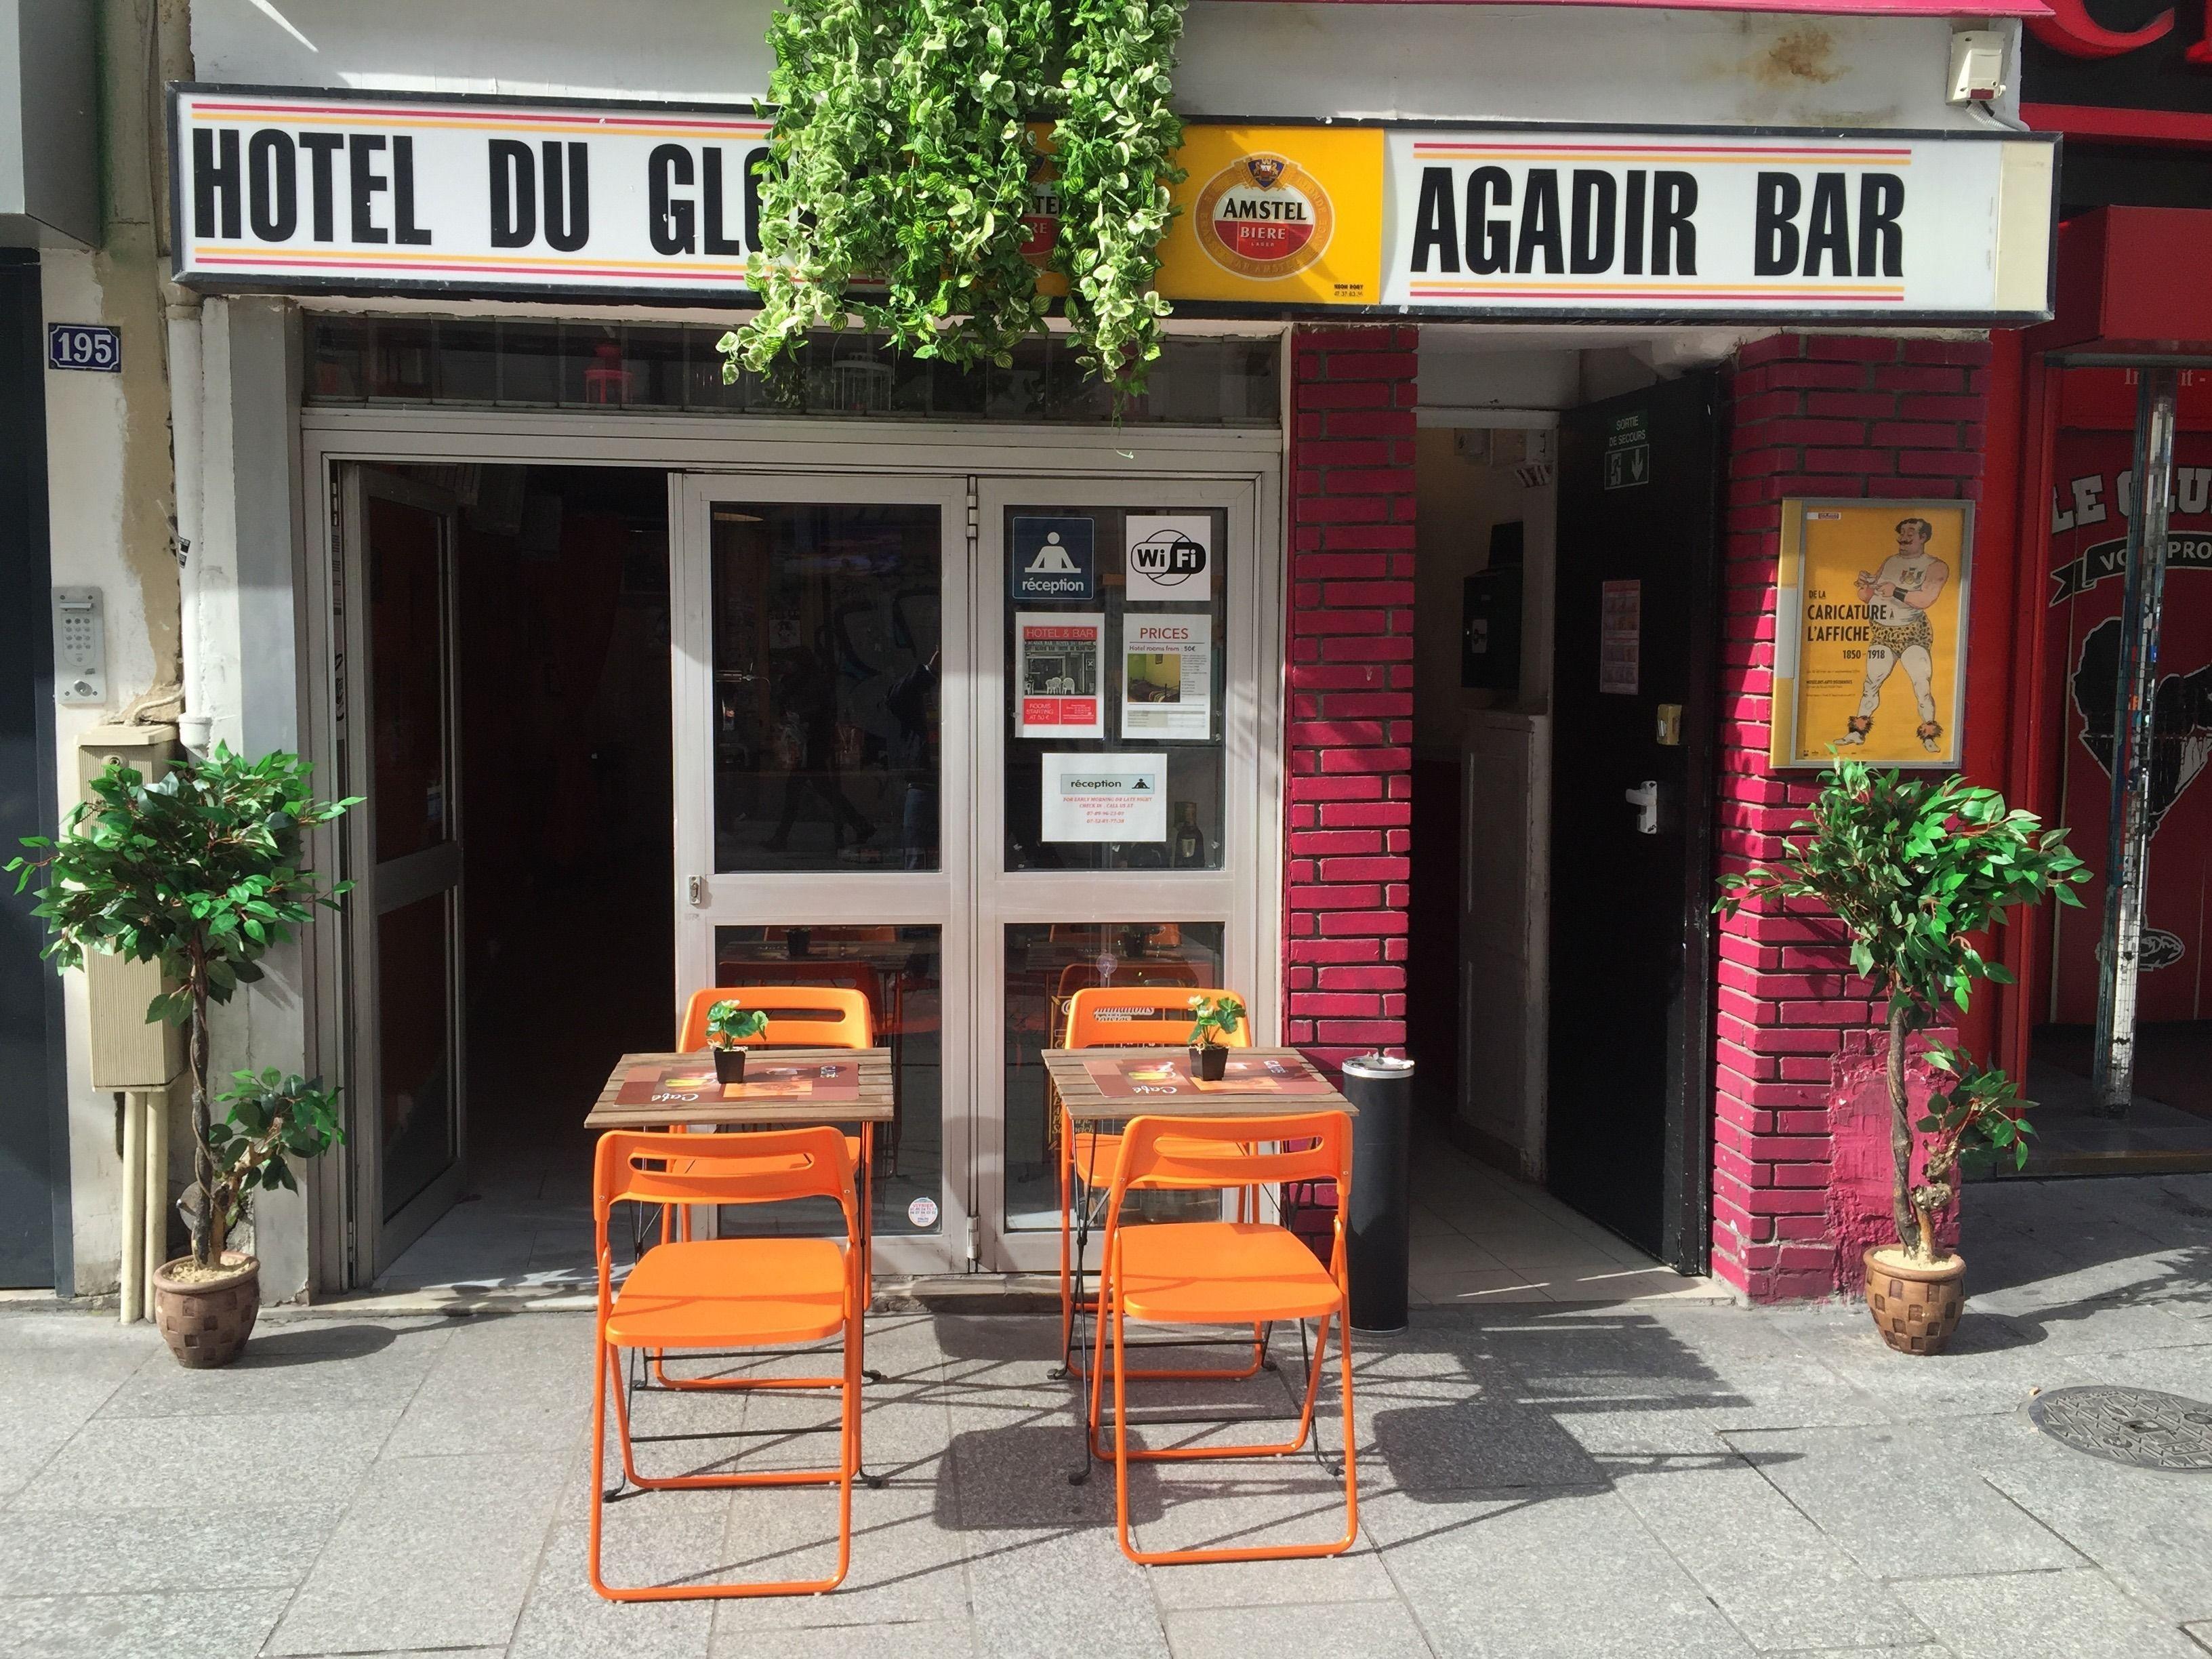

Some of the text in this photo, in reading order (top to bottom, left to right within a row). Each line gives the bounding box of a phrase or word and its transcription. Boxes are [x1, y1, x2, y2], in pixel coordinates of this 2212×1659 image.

[192, 127, 432, 245] HOTEL
[489, 138, 590, 253] DU
[1223, 197, 1307, 221] AMSTEL
[1410, 165, 1906, 277] AGADIR BAR
[1240, 226, 1286, 239] BIERE
[58, 332, 112, 363] 195
[1616, 415, 1639, 431] SORTIE
[1609, 429, 1646, 447] DE SECOURS
[2051, 474, 2106, 534] LE
[1022, 577, 1084, 594] réception
[1809, 590, 1817, 598] DE
[1807, 604, 1887, 620] CARICATURE
[1026, 628, 1060, 638] HOTEL
[1073, 629, 1094, 638] BAR
[1140, 628, 1189, 639] PRICES
[1807, 626, 1870, 642] L'AFFICHE
[1843, 649, 1862, 659] 1850
[1868, 649, 1885, 659] 1918
[1071, 779, 1122, 789] réception
